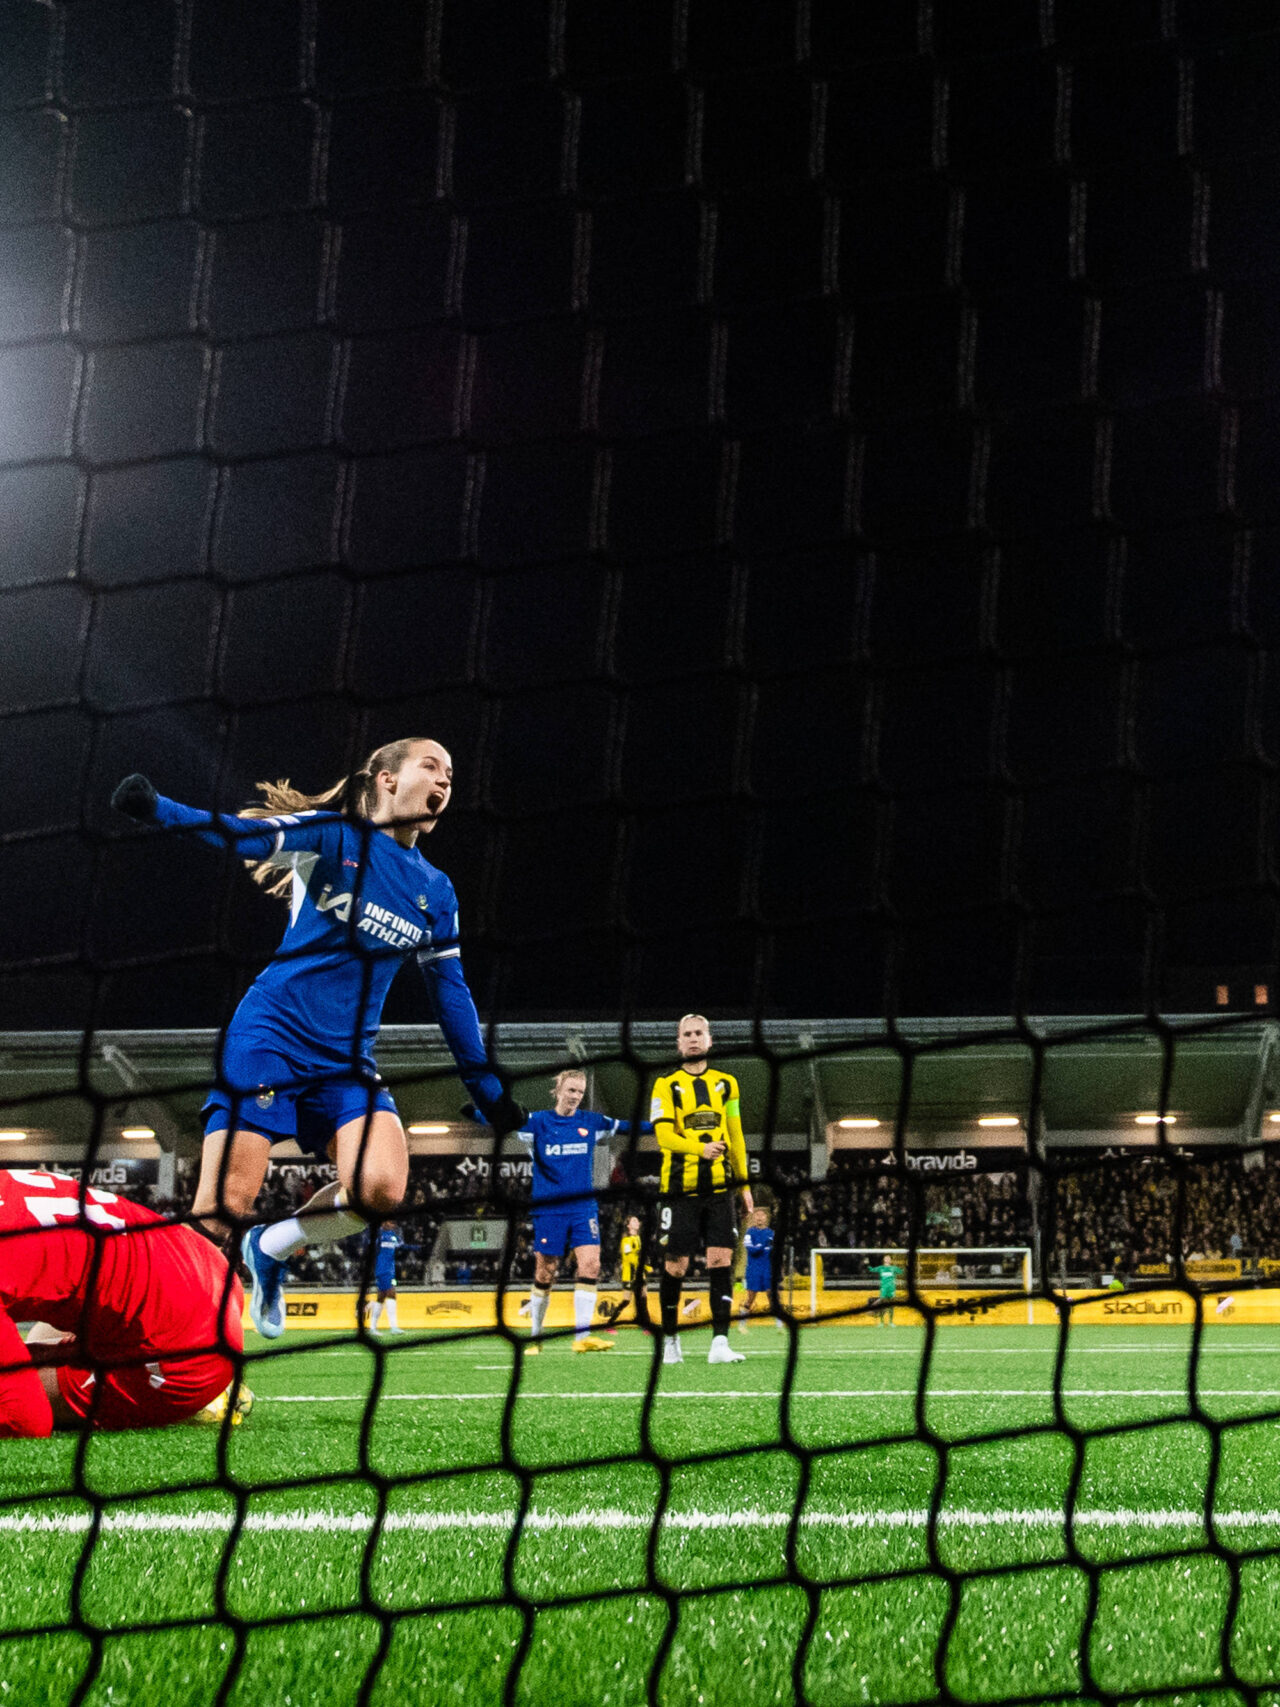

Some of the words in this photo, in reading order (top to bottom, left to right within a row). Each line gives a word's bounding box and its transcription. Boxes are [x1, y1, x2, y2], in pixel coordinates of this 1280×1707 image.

[905, 1150, 978, 1170] bravida
[660, 1206, 672, 1230] 9
[1103, 1299, 1183, 1316] stadium
